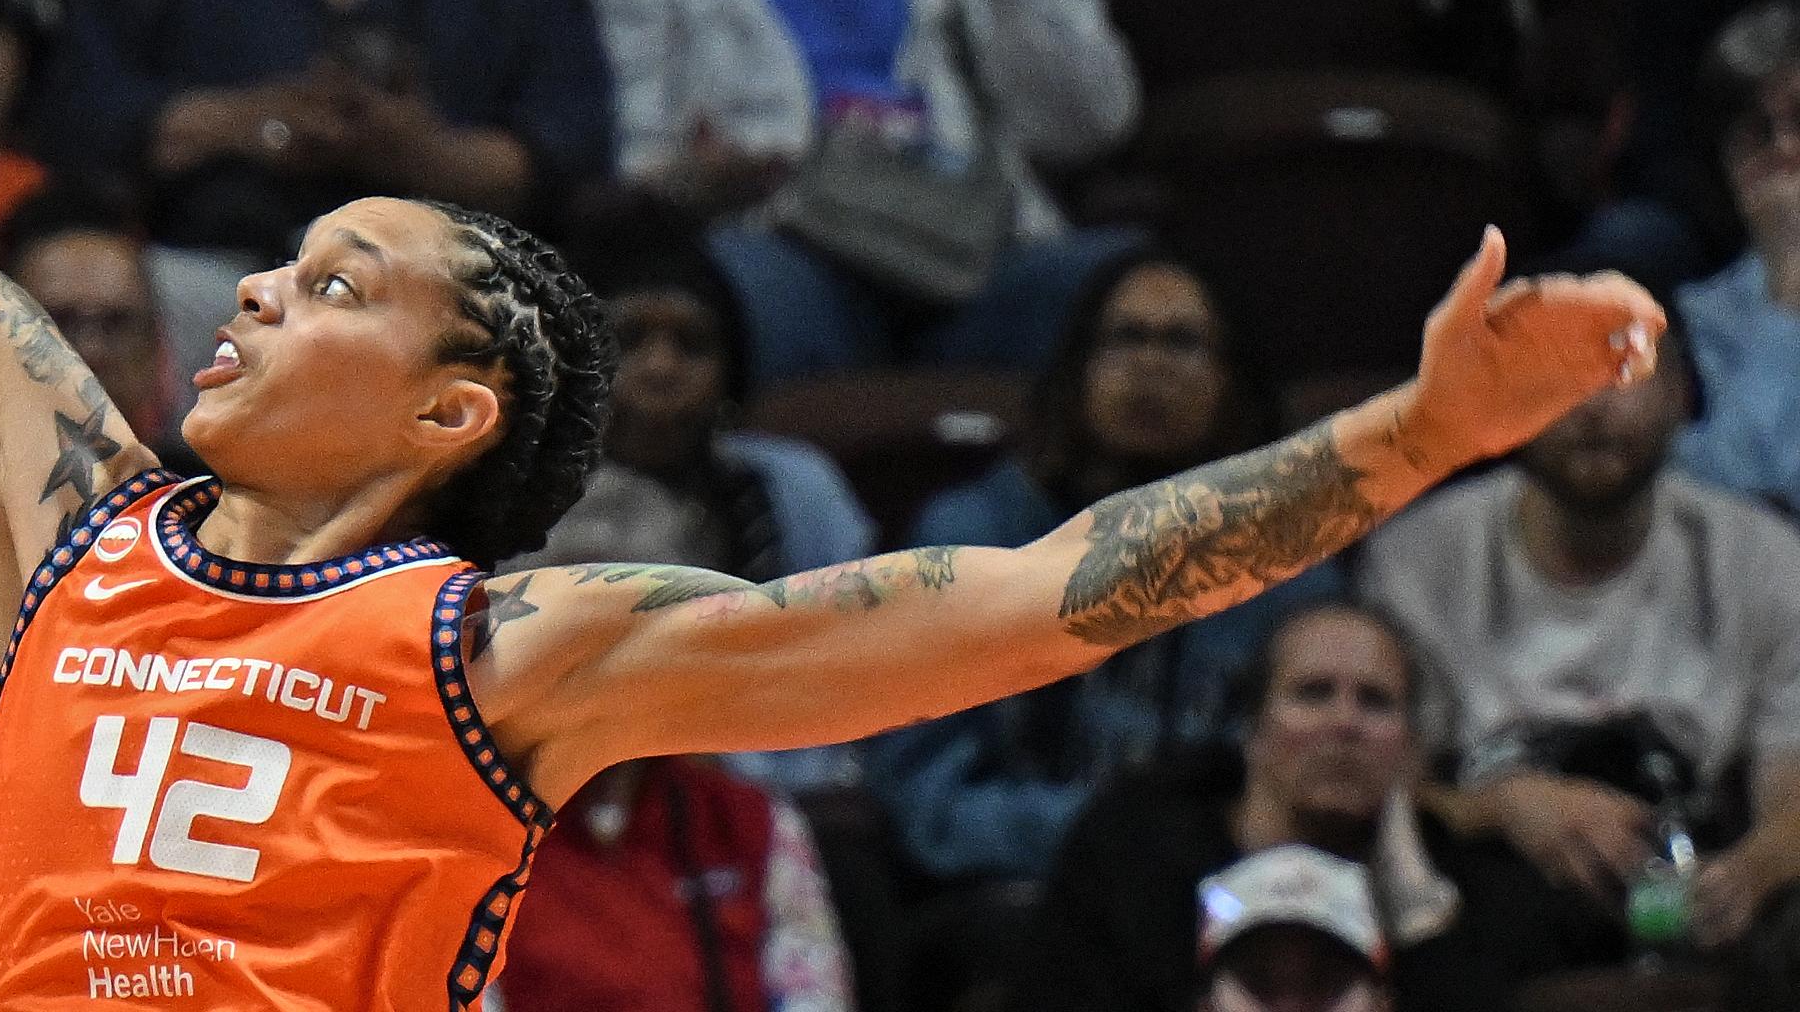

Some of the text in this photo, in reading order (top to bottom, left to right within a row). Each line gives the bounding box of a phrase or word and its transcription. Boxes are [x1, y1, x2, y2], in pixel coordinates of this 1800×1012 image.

[52, 646, 387, 730] CONNECTICUT
[79, 715, 292, 883] 42
[74, 896, 142, 924] Yale
[83, 924, 236, 962] NewHaen
[87, 964, 194, 1000] Health
